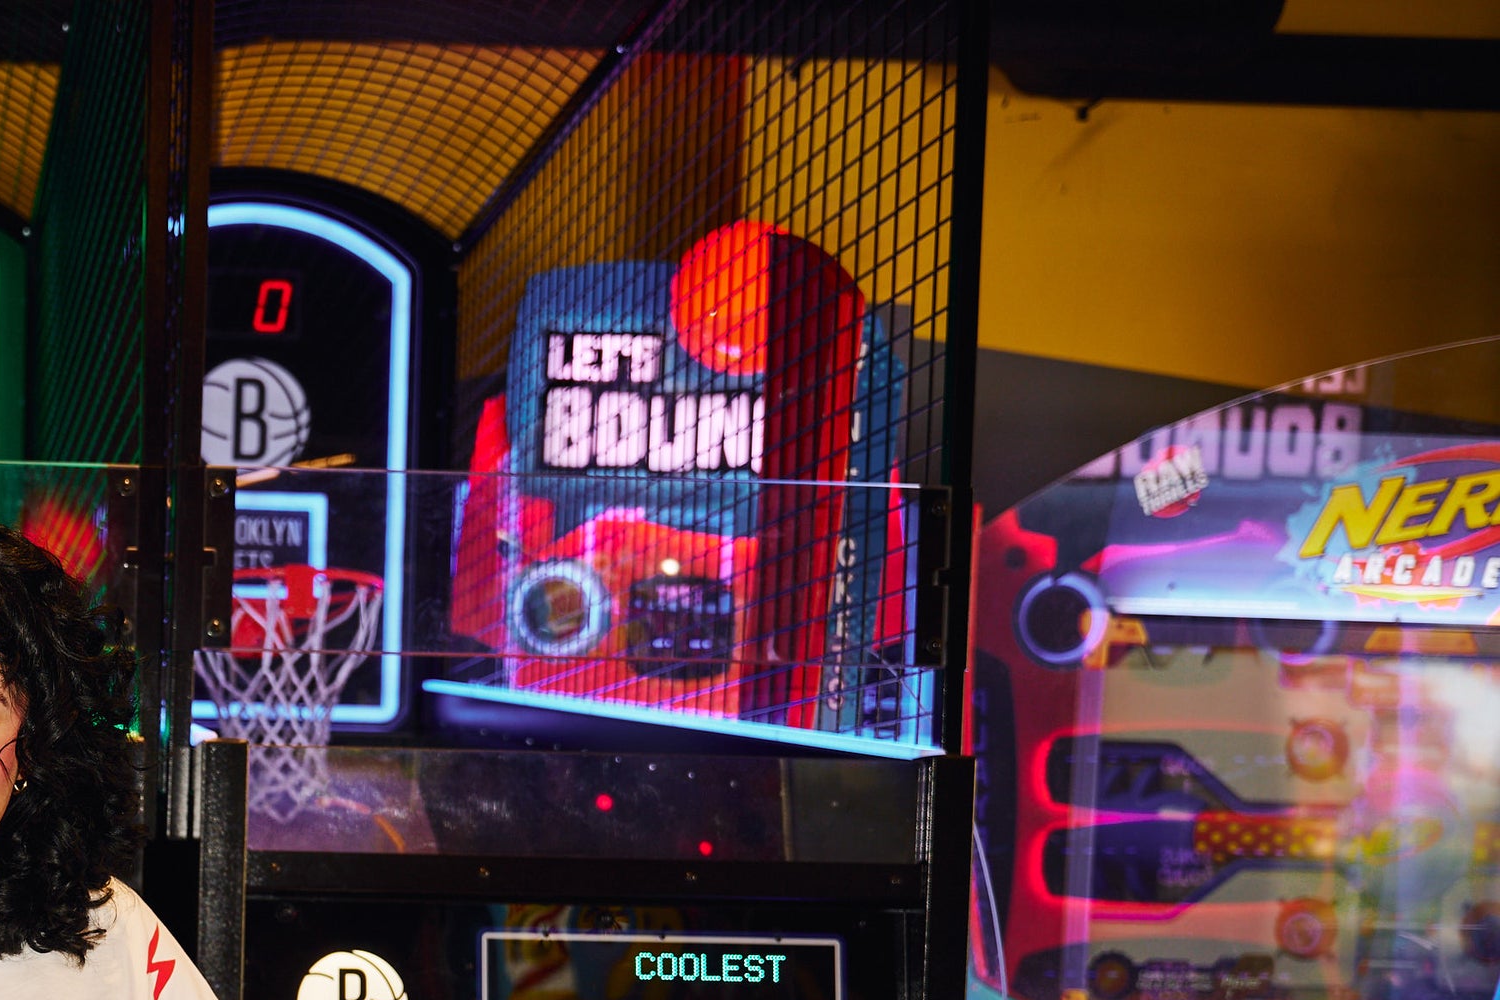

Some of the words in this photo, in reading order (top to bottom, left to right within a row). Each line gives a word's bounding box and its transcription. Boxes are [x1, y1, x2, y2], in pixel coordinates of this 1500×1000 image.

[252, 280, 292, 333] 0
[547, 333, 662, 383] LET'S
[232, 377, 267, 461] B
[235, 516, 302, 546] OKLYN
[1299, 469, 1500, 558] NER
[234, 550, 275, 569] ETS
[1333, 553, 1500, 588] ARCADE
[635, 951, 786, 983] COOLEST
